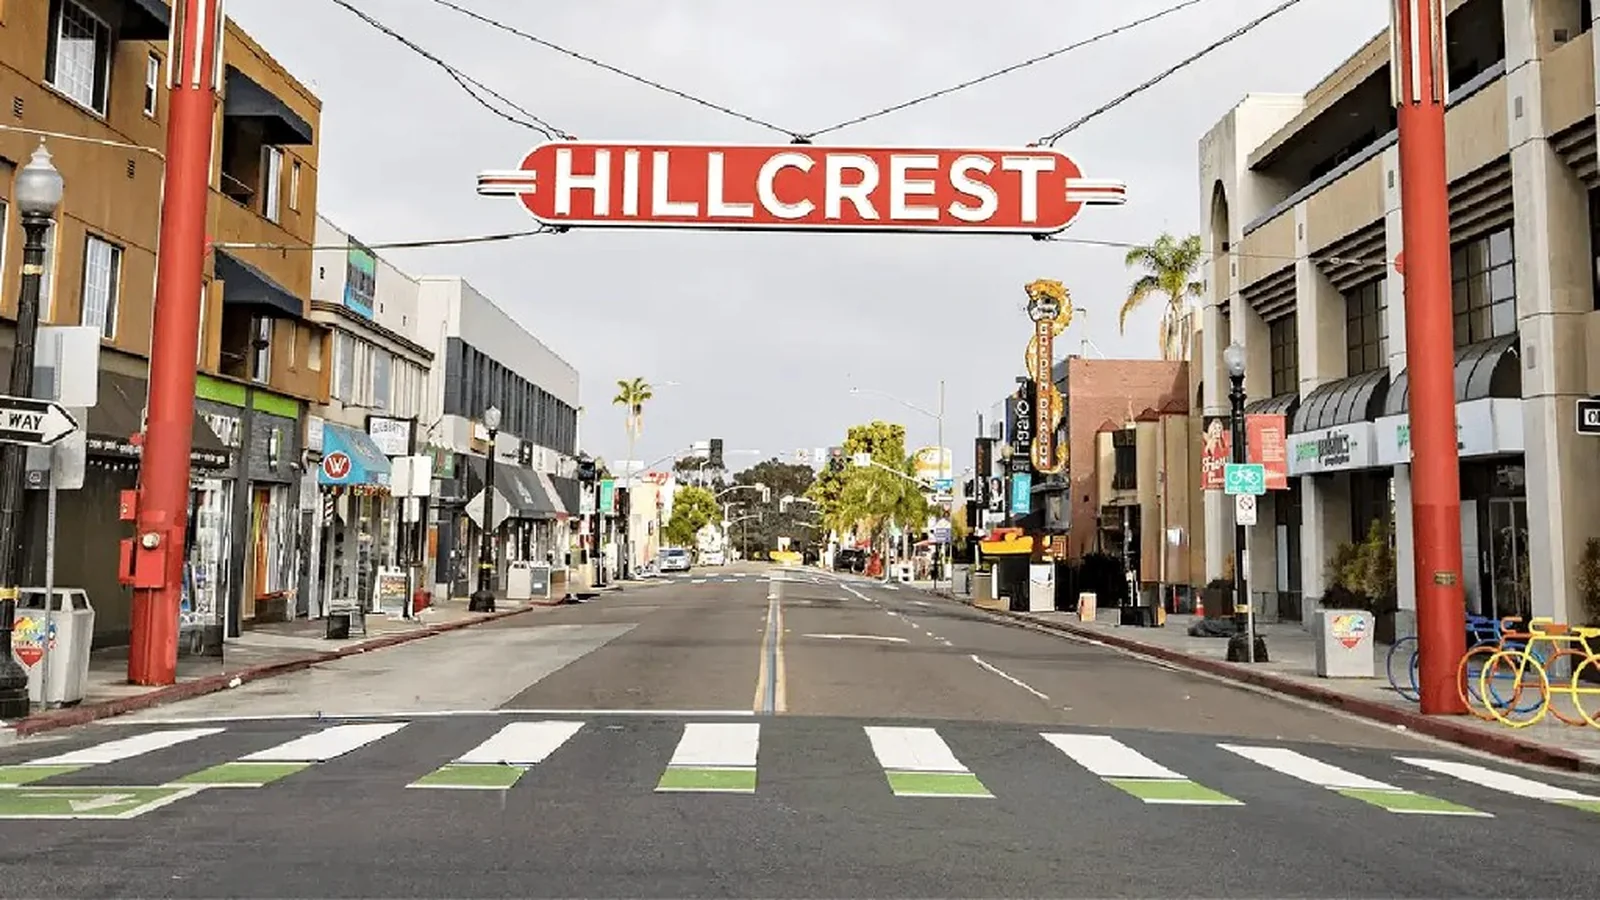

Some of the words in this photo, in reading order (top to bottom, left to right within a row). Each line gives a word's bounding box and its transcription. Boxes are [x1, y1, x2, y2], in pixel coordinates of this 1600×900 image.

[554, 148, 1056, 223] HILLCREST
[9, 413, 43, 430] WAY
[1041, 398, 1049, 466] DRAGON
[328, 457, 347, 475] W
